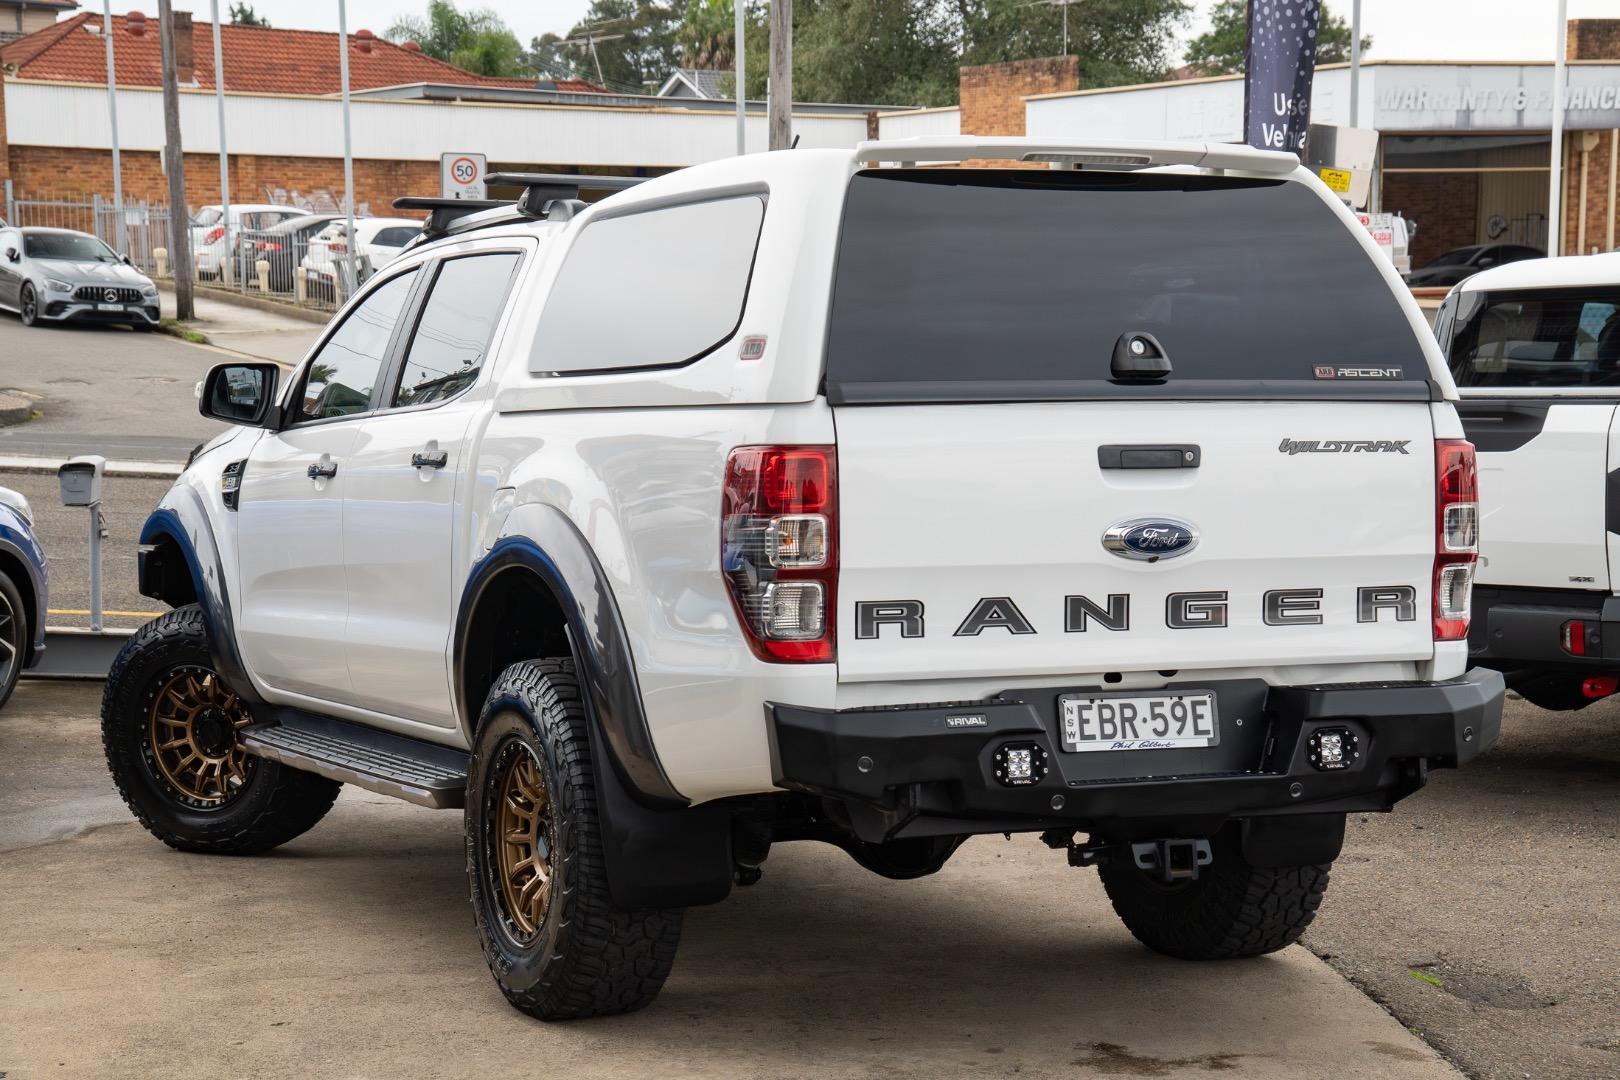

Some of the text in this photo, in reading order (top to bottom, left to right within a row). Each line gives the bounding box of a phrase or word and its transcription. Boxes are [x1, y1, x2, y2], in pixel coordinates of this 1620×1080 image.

[1379, 87, 1508, 111] WARRANTY
[1511, 87, 1528, 111] &
[456, 165, 474, 177] 50
[1337, 368, 1401, 377] ASCENT
[1278, 438, 1412, 455] WILDTRAK
[1139, 528, 1179, 548] Ford
[855, 584, 1417, 640] RANGER
[954, 716, 986, 726] RIVAL
